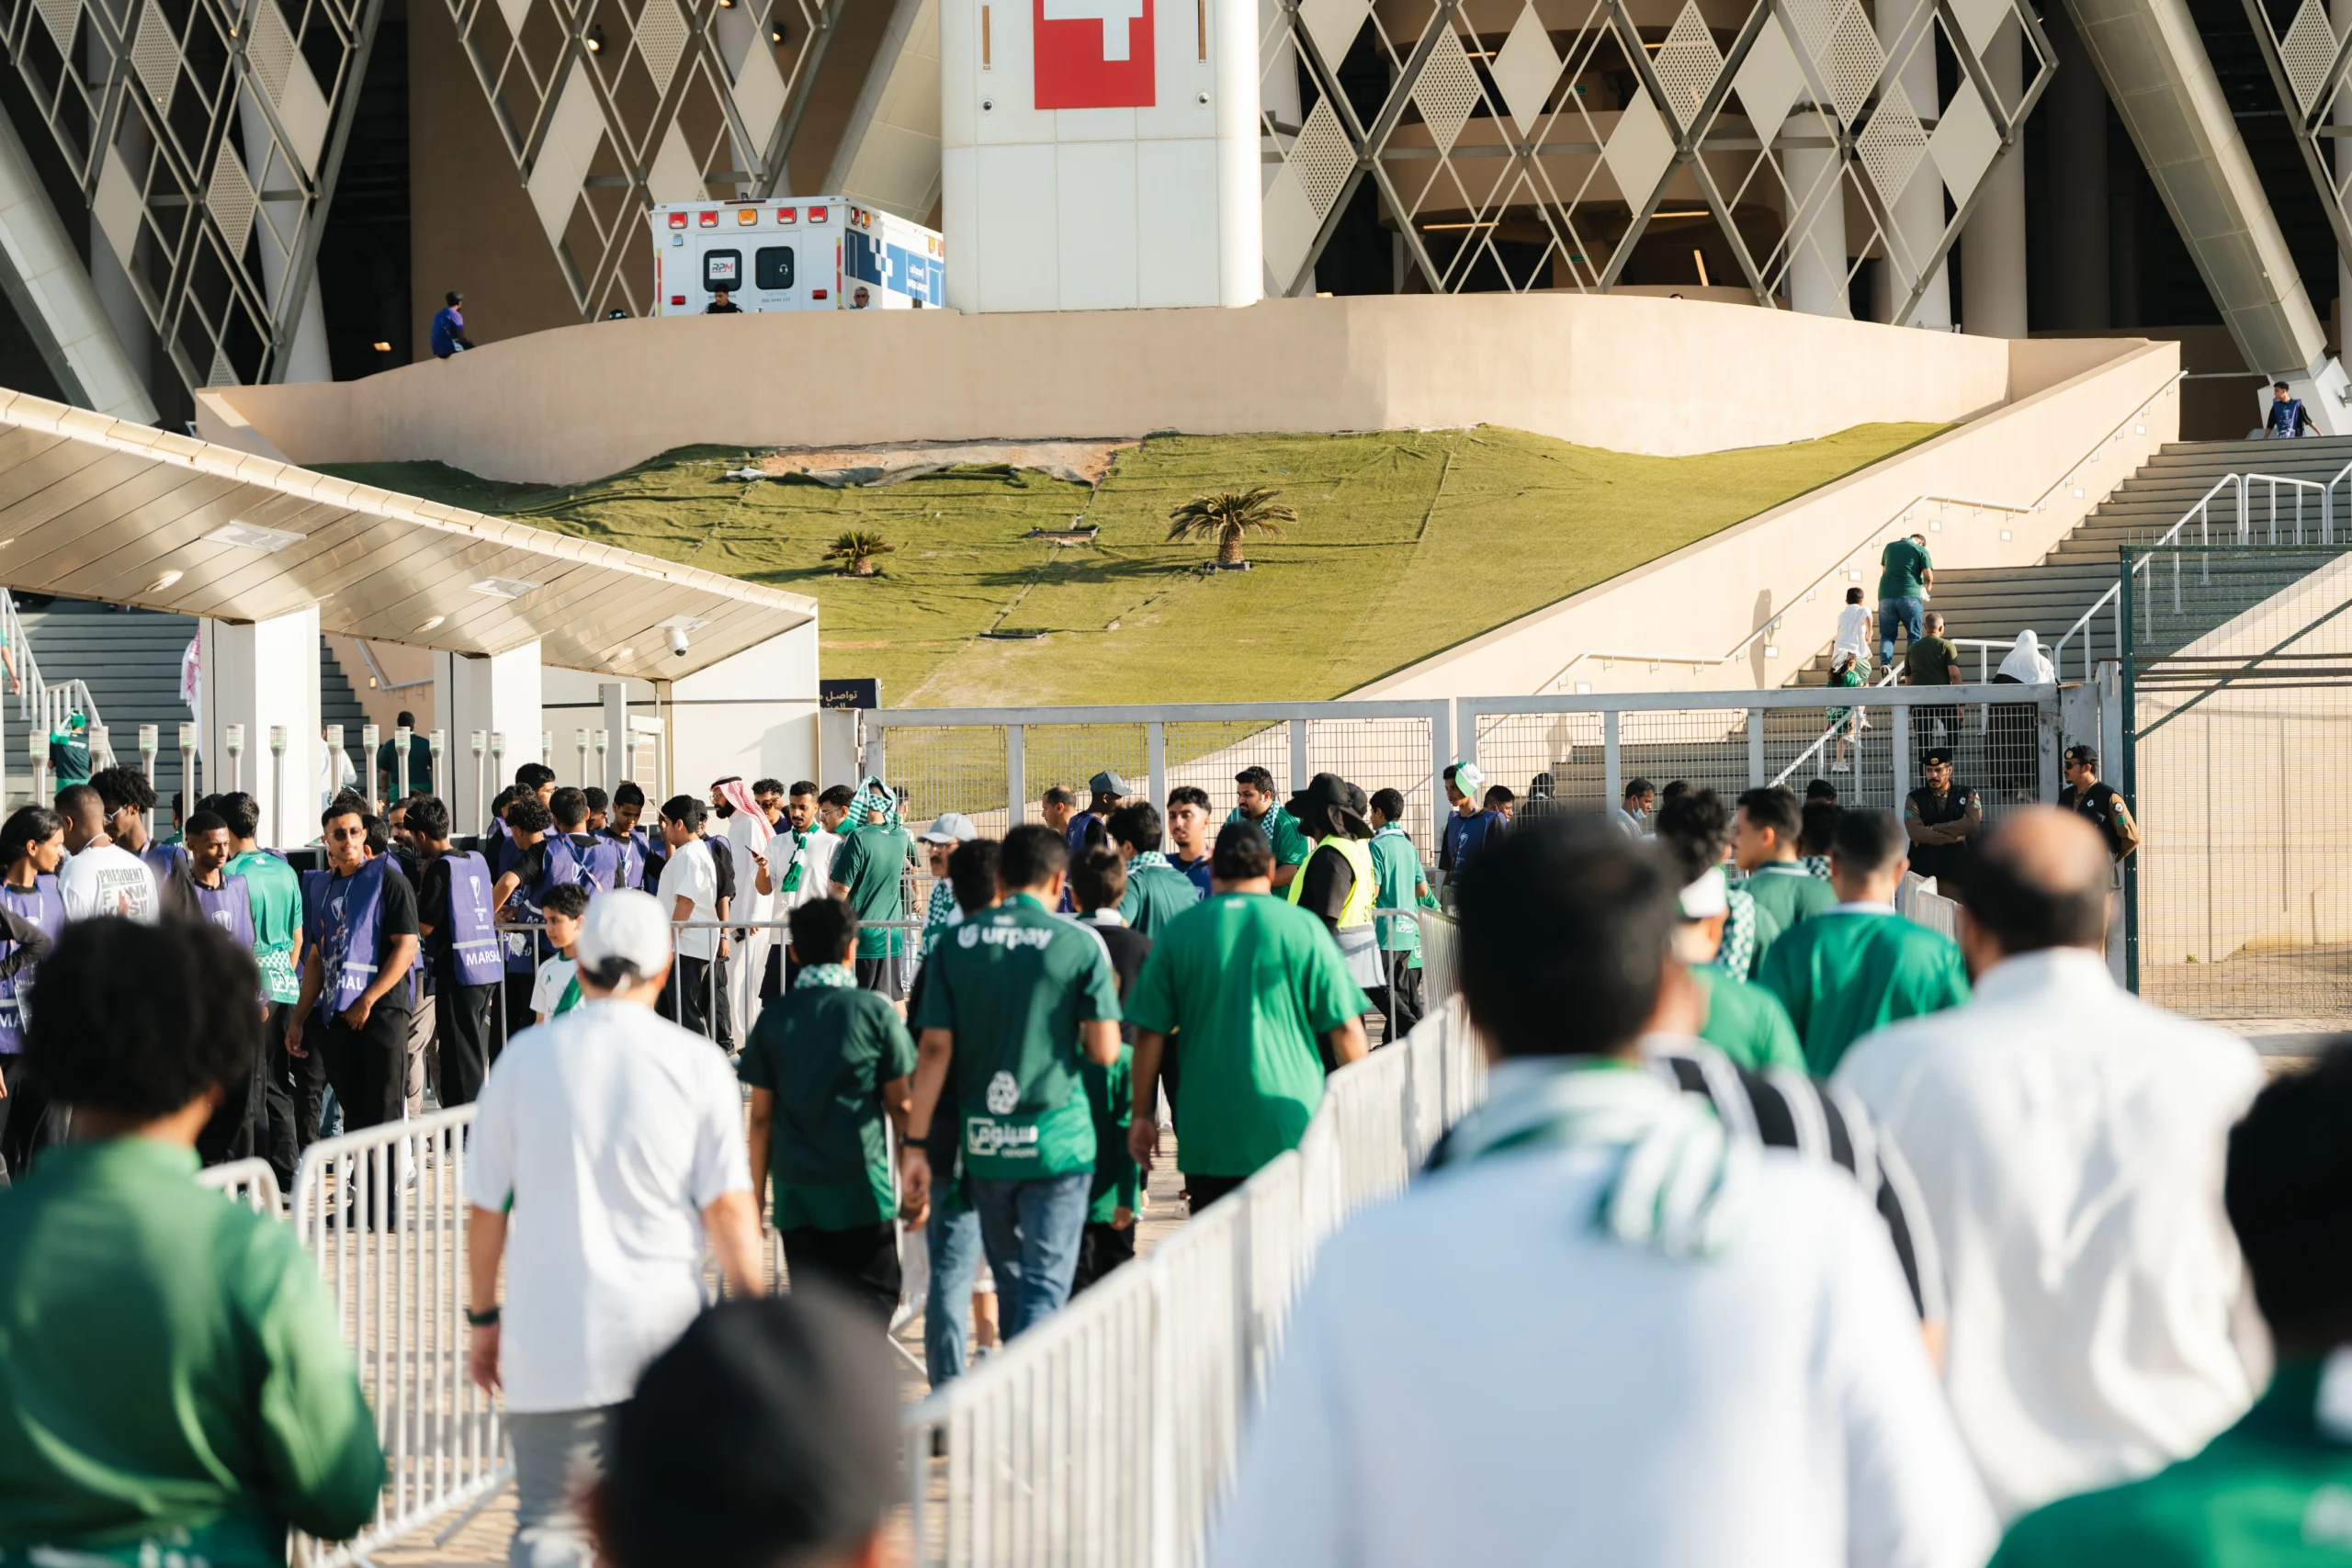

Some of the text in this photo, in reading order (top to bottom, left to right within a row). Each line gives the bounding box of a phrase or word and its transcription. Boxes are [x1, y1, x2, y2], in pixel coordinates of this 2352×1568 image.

[711, 263, 734, 273] RPM
[825, 690, 858, 702] تواصل
[97, 867, 145, 884] PRESIDENT
[981, 926, 1054, 951] urpay
